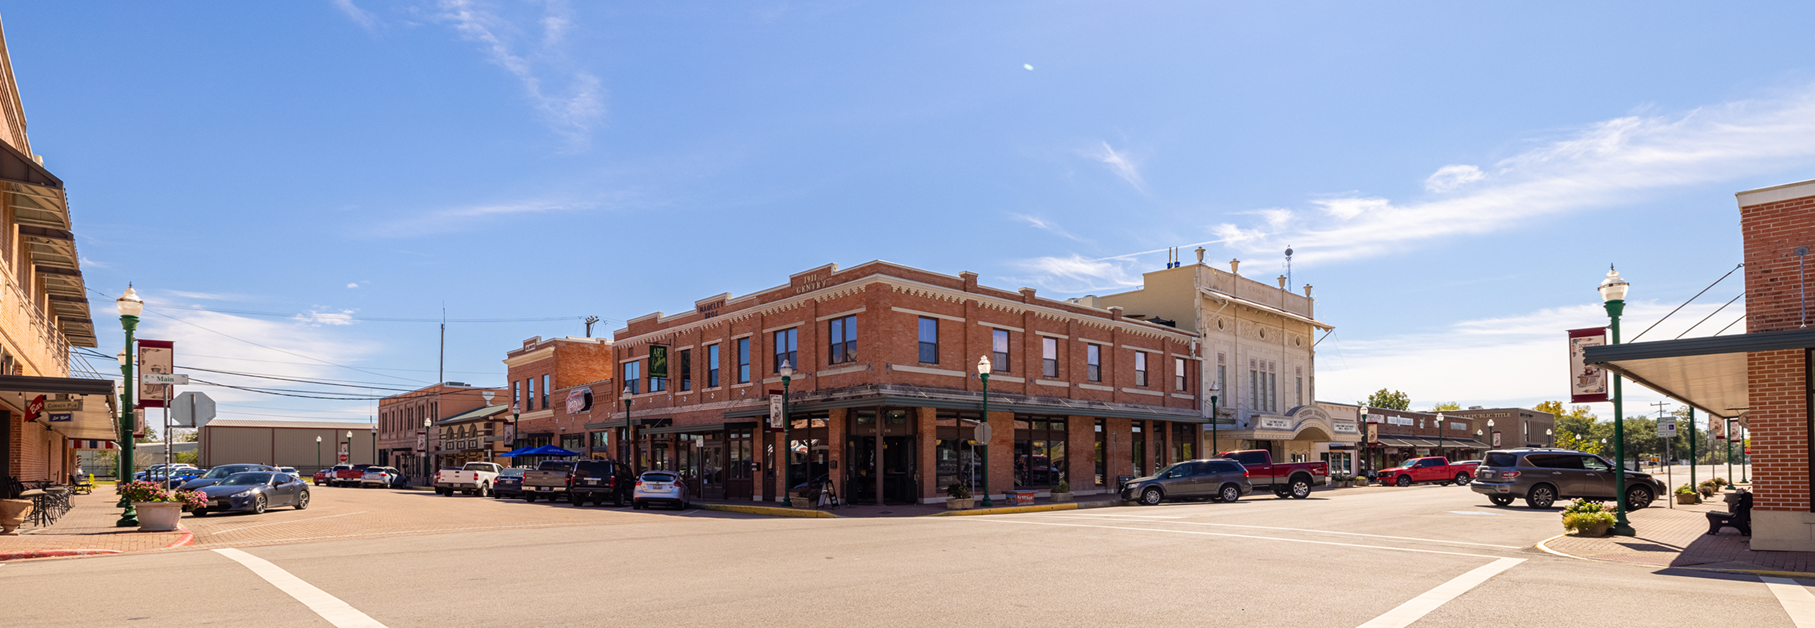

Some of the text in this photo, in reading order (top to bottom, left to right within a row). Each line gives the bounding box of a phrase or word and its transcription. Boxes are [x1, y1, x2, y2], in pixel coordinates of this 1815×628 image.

[804, 274, 817, 284] 1911
[796, 280, 827, 294] GENTRY
[653, 347, 664, 357] ART
[29, 402, 43, 415] Bar
